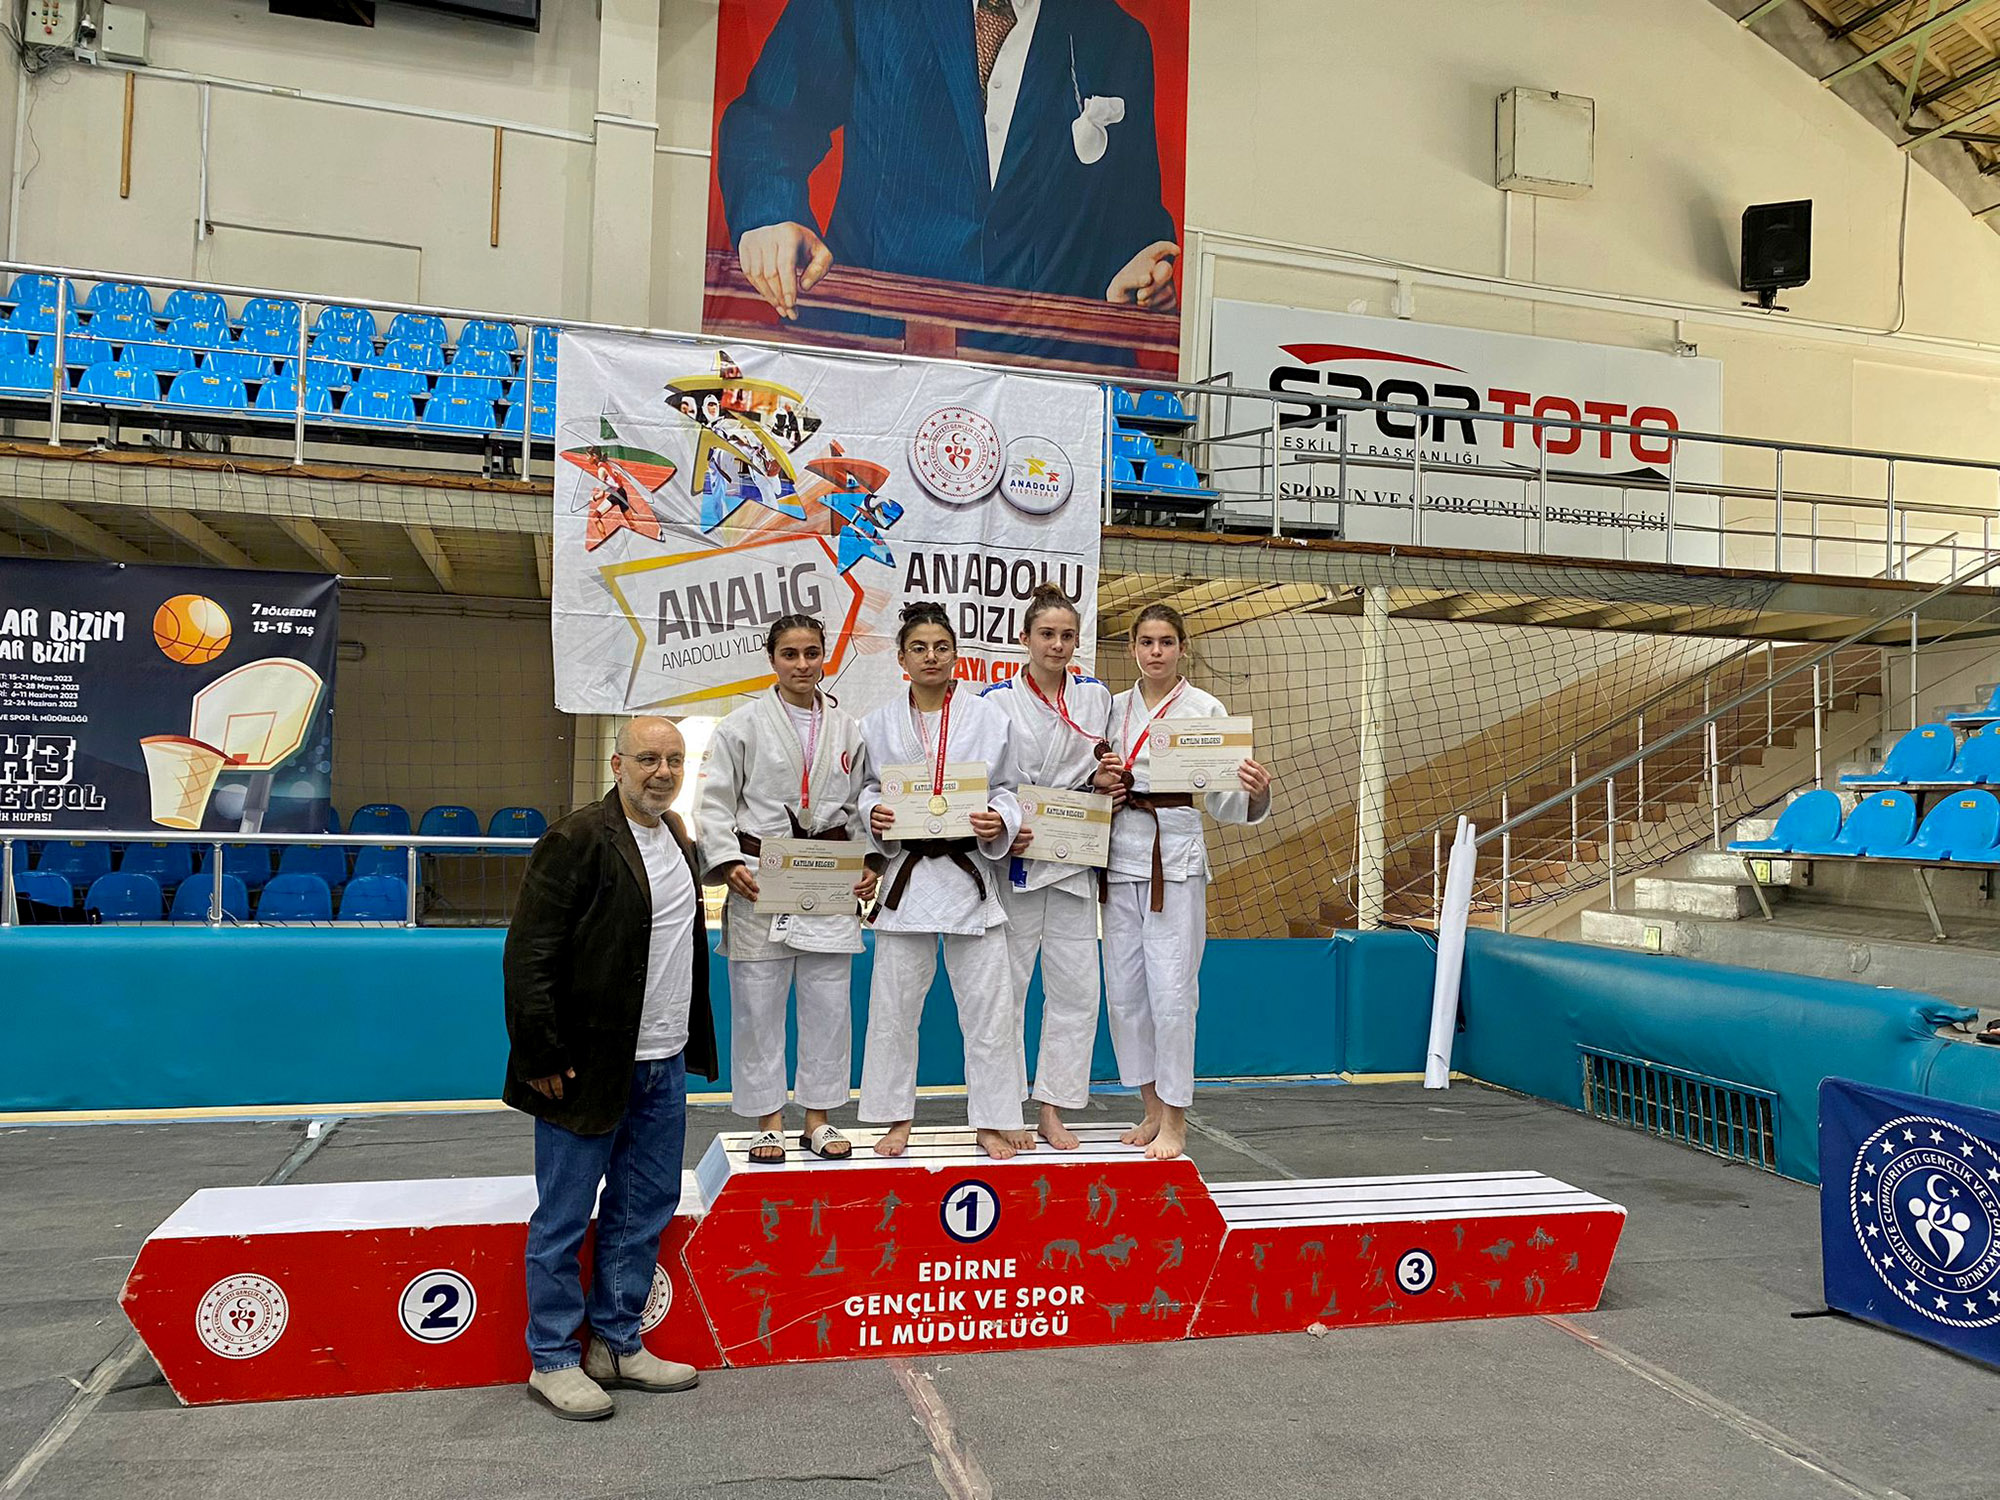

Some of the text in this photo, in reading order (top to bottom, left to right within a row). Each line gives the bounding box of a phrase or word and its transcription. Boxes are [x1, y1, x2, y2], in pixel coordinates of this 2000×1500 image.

[1277, 436, 1358, 454] EŞKİLT
[1010, 480, 1059, 492] ANADOLU
[0, 608, 38, 636] AR
[252, 603, 316, 618] 7 BÖLGEDEN
[253, 620, 314, 637] 13-15 YAŞ
[662, 641, 730, 671] ANADOLU
[1922, 1153, 1973, 1182] GENÇLİK
[1882, 1152, 1922, 1223] CUMHURİYETİ
[1973, 1180, 1988, 1199] VE
[956, 1191, 978, 1232] 1
[1887, 1225, 1926, 1277] TÜRKİYE
[1955, 1239, 2000, 1289] BAKANLIĞI
[918, 1254, 1017, 1282] EDİRNE
[1406, 1258, 1426, 1286] 3
[420, 1284, 460, 1330] 2
[844, 1285, 1086, 1320] GENÇLİK VE SPOR
[859, 1311, 1070, 1347] İL MÜDÜRLÜĞÜ
